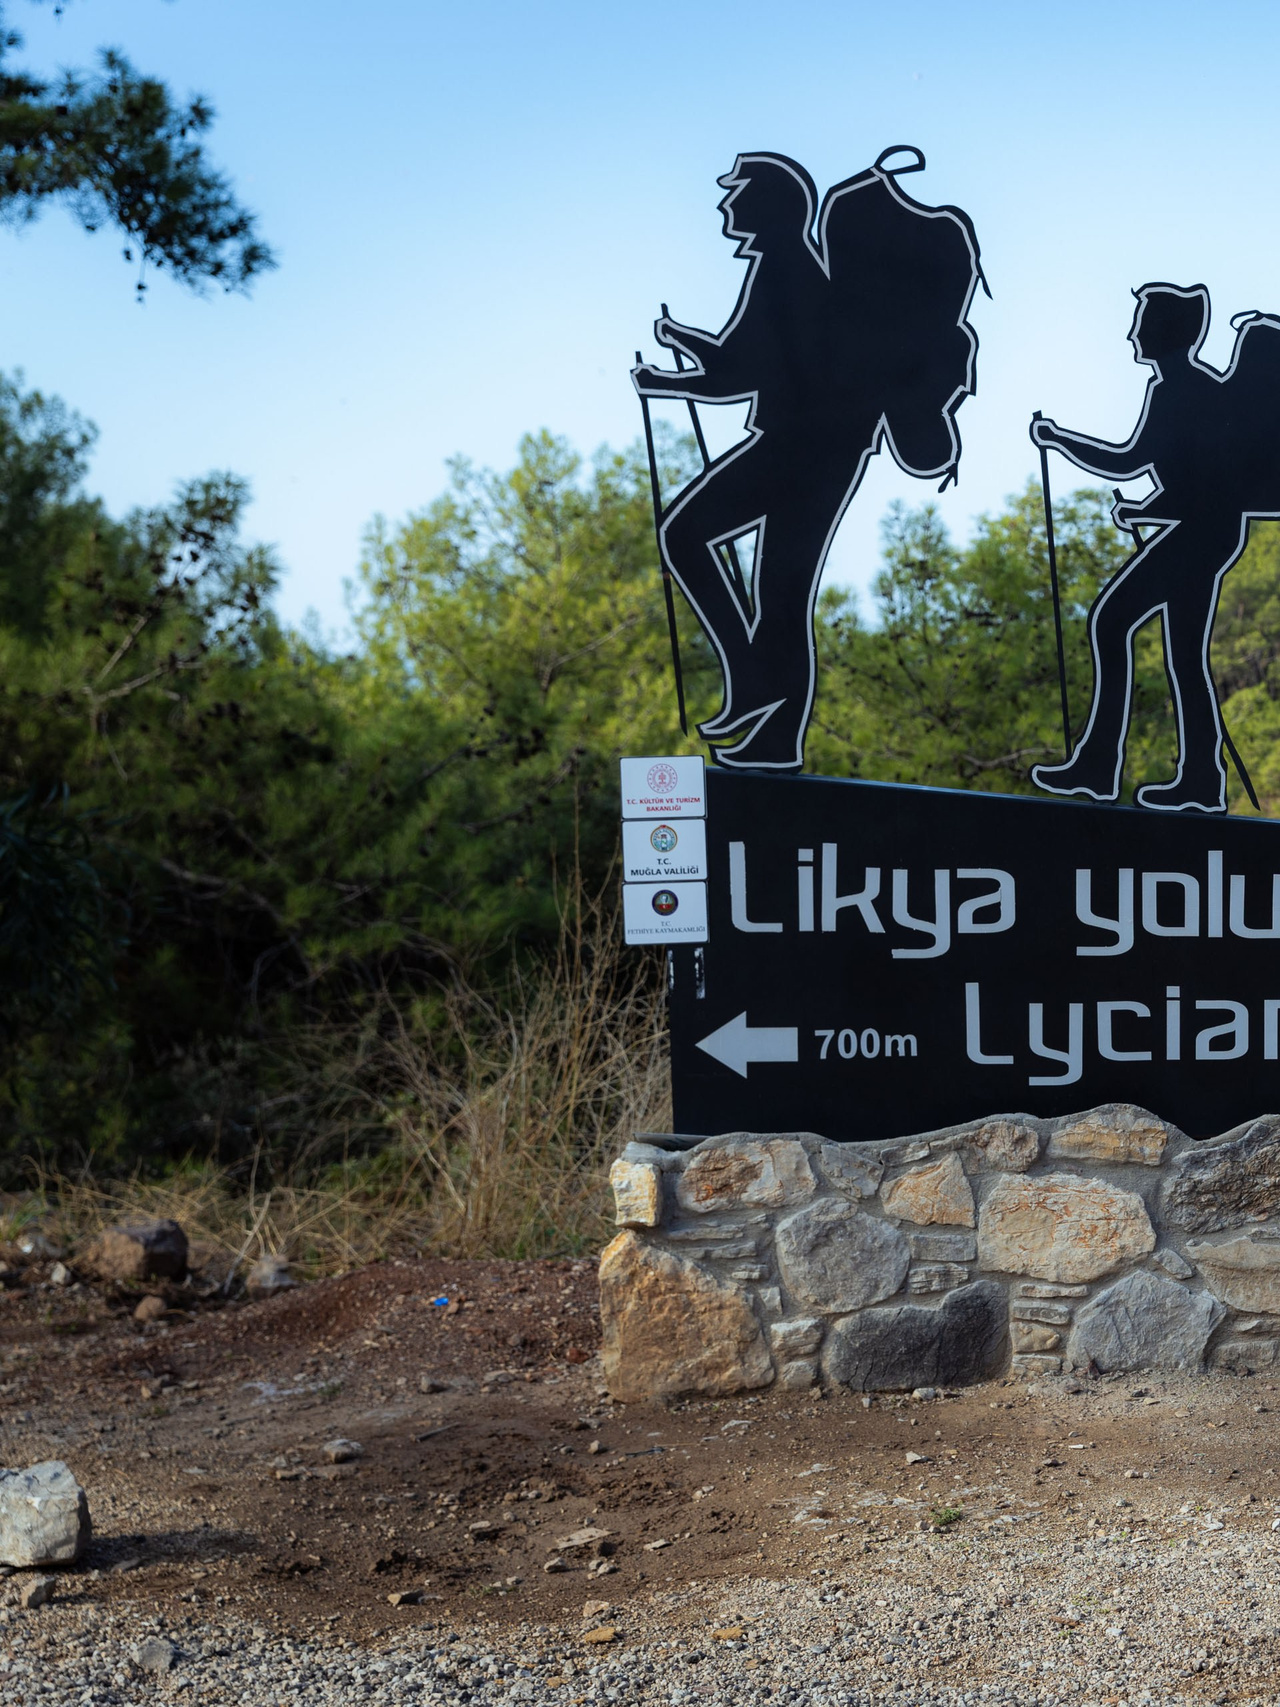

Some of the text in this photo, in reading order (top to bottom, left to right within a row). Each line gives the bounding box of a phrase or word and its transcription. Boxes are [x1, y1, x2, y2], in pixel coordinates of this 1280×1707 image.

[639, 797, 664, 805] KÜLTÜR
[675, 796, 701, 804] TURİZM
[646, 804, 682, 812] BAKANLIĞI
[656, 858, 672, 866] T.C.
[630, 865, 700, 877] MUĞLA VALİLİĞİ
[729, 842, 1016, 958] Likya
[655, 925, 706, 934] KAYMAKAMLIĞI
[814, 1027, 918, 1060] 700m
